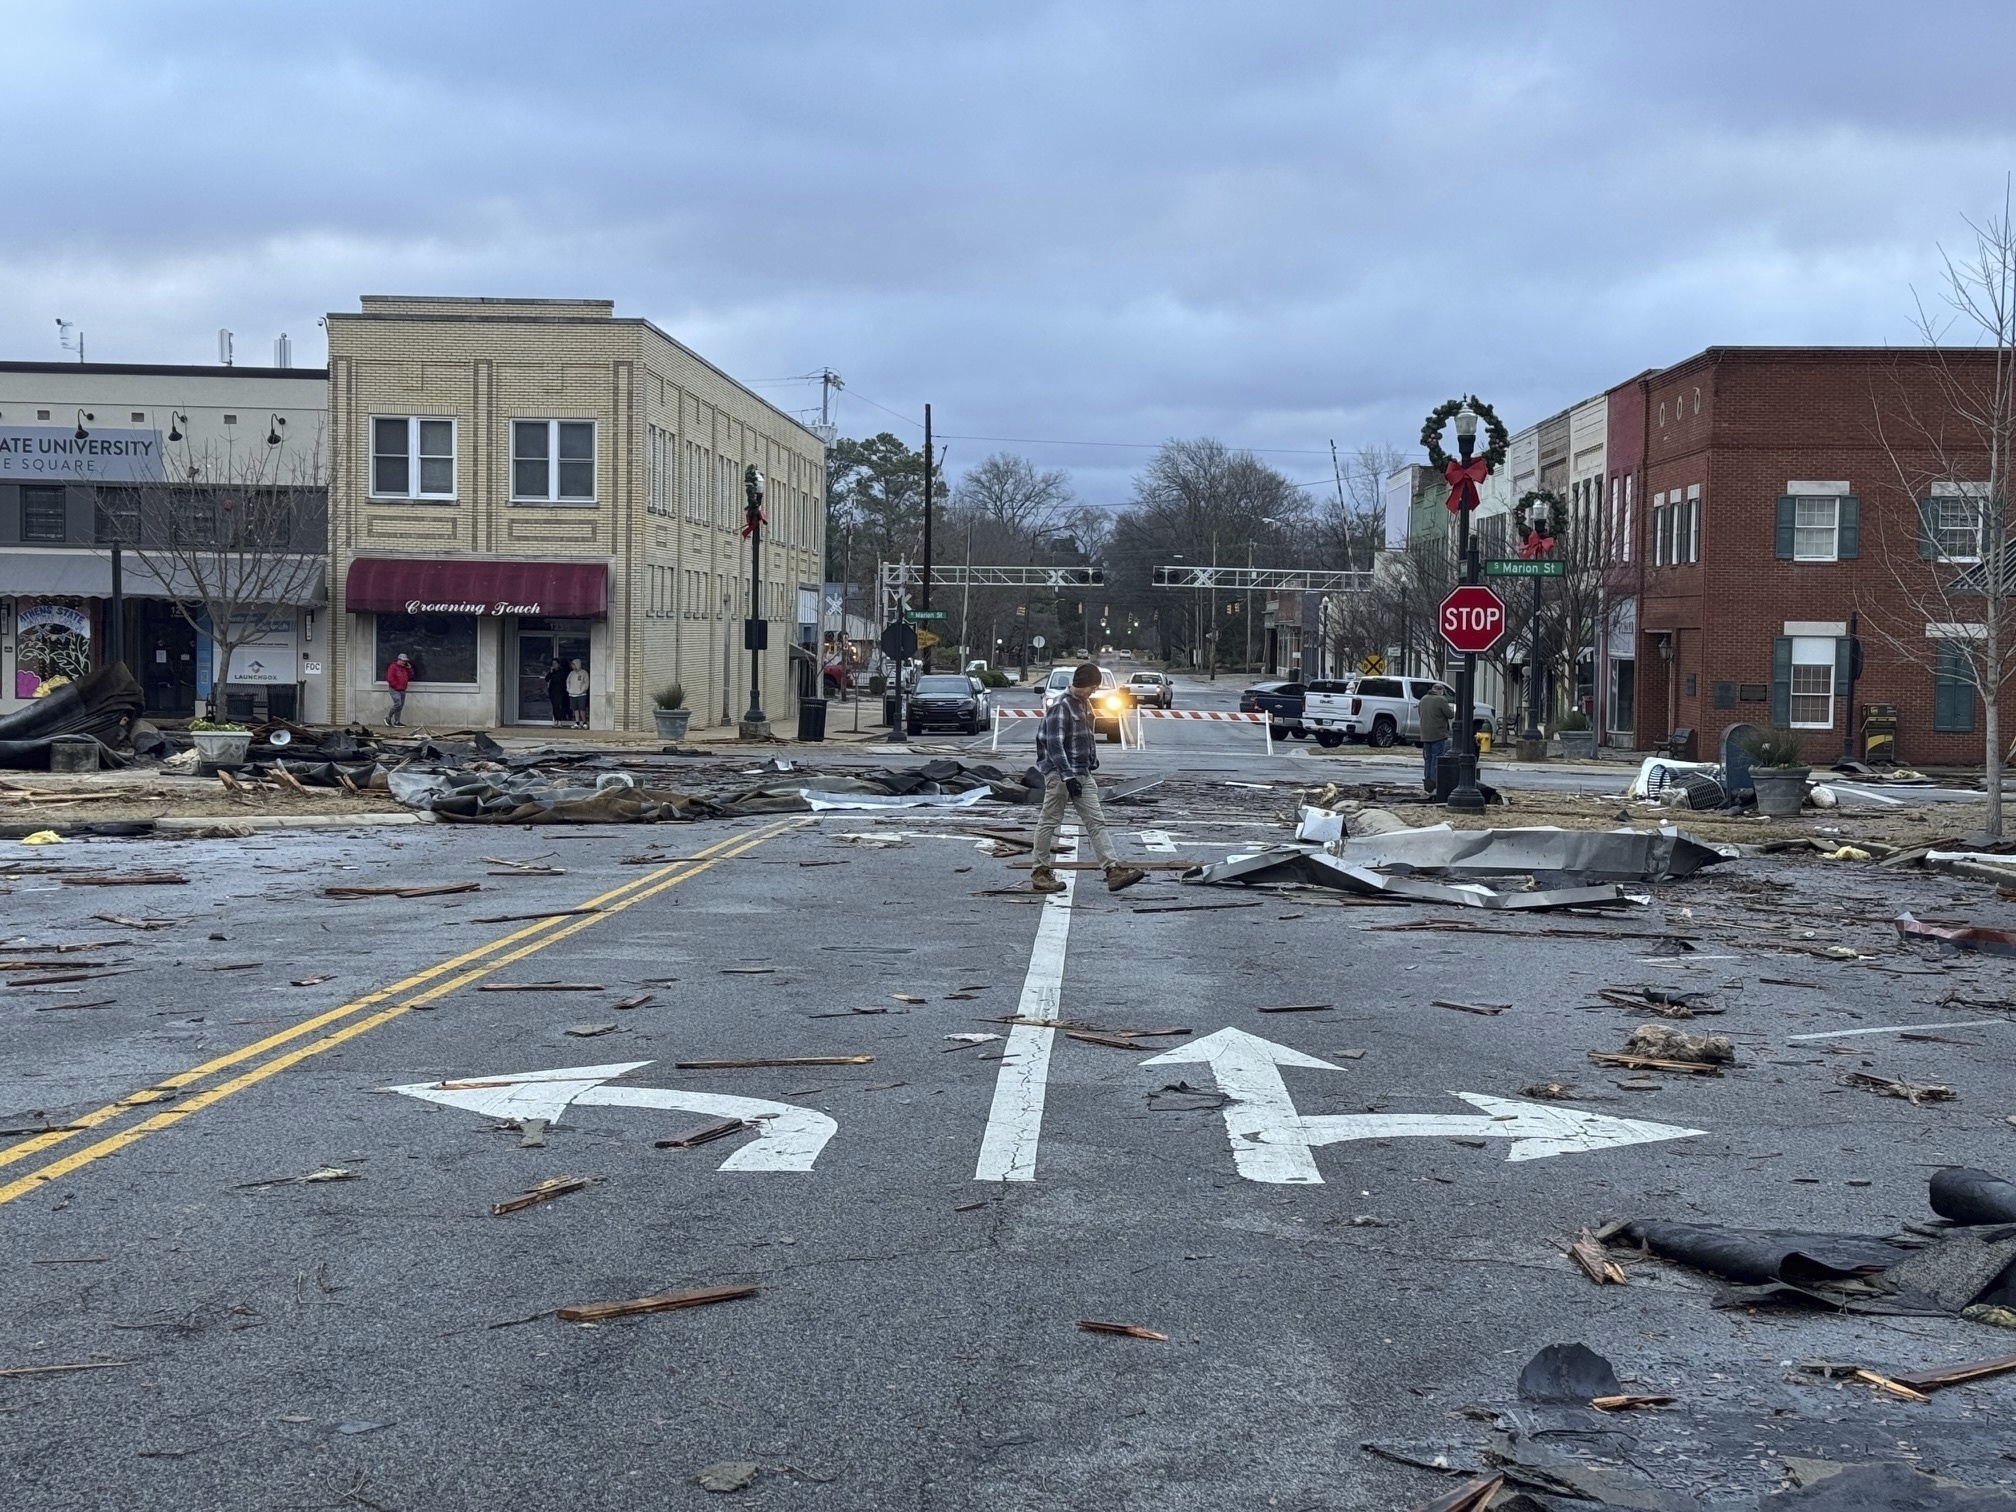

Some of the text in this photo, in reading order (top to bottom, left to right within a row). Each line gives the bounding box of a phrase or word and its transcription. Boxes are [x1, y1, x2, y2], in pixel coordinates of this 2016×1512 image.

[38, 438, 153, 456] UNIVERSITY
[21, 458, 95, 473] SQUARE
[1502, 562, 1539, 574] Marion
[1543, 562, 1555, 574] St
[405, 599, 541, 616] Crowning Touch
[915, 611, 935, 619] Marion
[936, 611, 943, 619] St
[19, 605, 53, 623] ATHENS
[55, 607, 86, 626] STATE
[1444, 607, 1500, 631] STOP
[550, 623, 564, 631] 123
[305, 662, 320, 671] FDC
